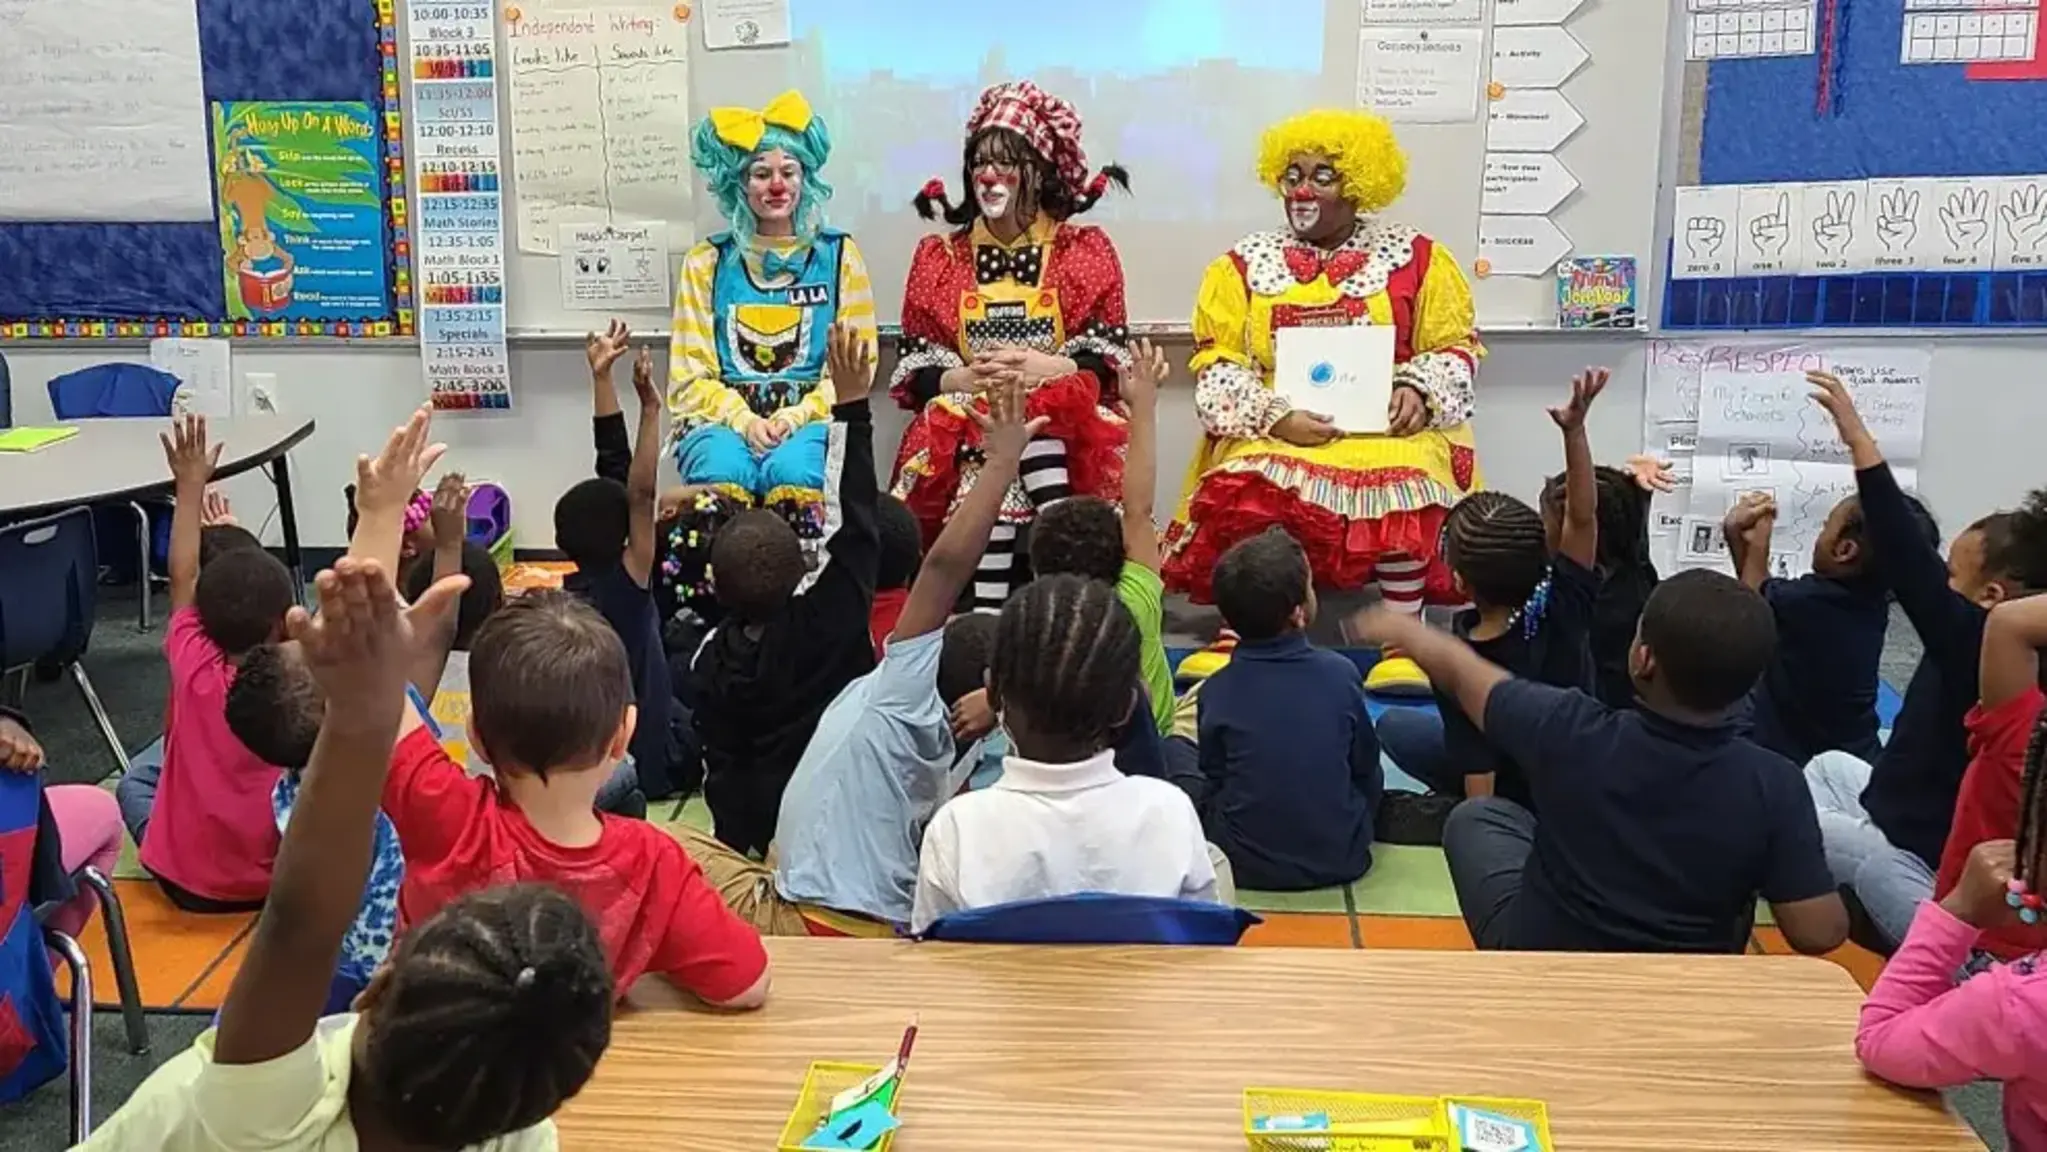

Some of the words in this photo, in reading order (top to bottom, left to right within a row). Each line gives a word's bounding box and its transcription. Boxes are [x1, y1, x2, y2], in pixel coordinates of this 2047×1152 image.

[414, 7, 488, 21] 10:00-10:35
[510, 12, 596, 38] Independent
[415, 43, 490, 56] 10:35-11:05
[611, 43, 649, 61] Sounds
[1509, 50, 1541, 58] Activity
[513, 47, 551, 65] Looks
[555, 47, 580, 62] like
[420, 125, 494, 137] 12:00-12:10
[436, 143, 479, 155] Recess
[424, 217, 455, 229] Math
[458, 217, 499, 229] Stories
[423, 254, 455, 266] Math
[458, 254, 490, 266] Block
[1815, 260, 1837, 268] two
[1840, 259, 1848, 268] 2
[1874, 256, 1903, 266] three
[1907, 256, 1915, 265] 3
[1942, 256, 1966, 265] four
[1970, 257, 1978, 265] 4
[2011, 254, 2031, 264] five
[2035, 254, 2043, 263] 5
[1687, 263, 1710, 272] zero
[293, 291, 320, 301] Read
[790, 289, 807, 305] LA
[809, 287, 828, 302] LA
[435, 310, 493, 322] 1:35-2:15
[439, 327, 489, 342] Specials
[428, 364, 461, 376] Math
